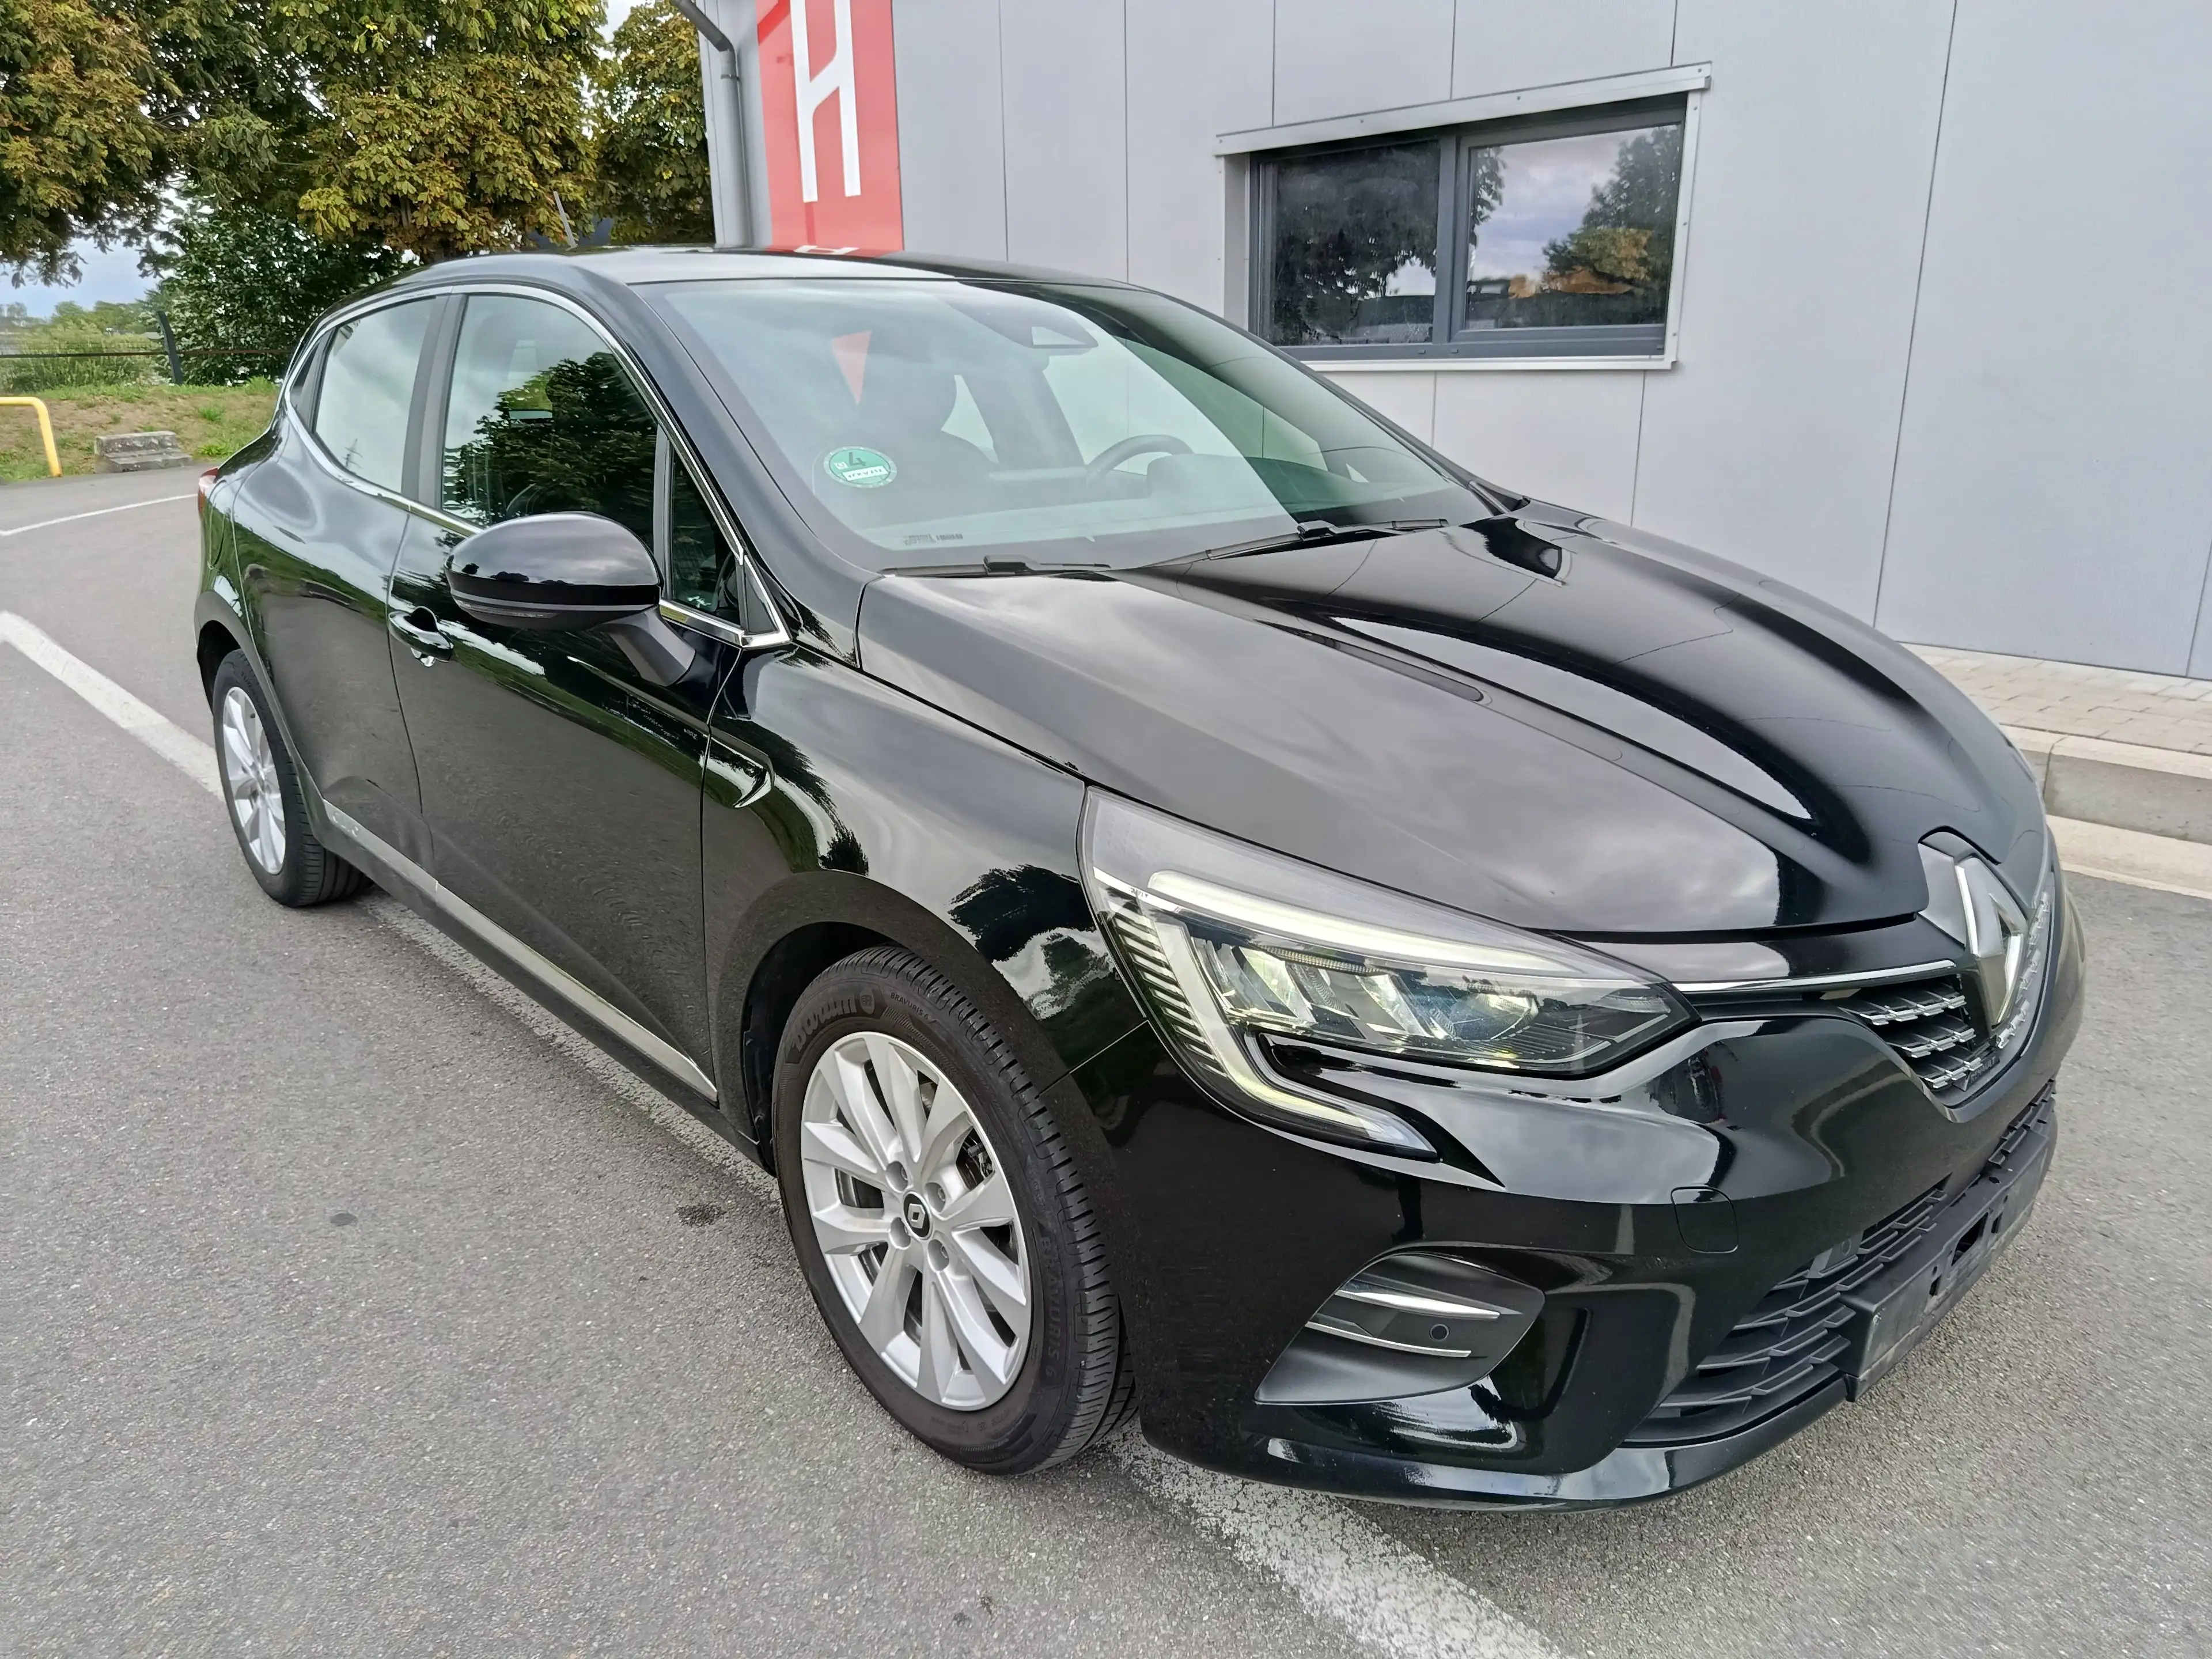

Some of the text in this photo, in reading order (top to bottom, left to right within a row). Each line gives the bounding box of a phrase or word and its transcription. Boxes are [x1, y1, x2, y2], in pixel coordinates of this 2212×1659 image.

[790, 0, 861, 203] H
[849, 452, 866, 466] 4
[890, 992, 923, 1016] BRAVURIS
[1039, 1236, 1062, 1361] BRAVURIS
[1045, 1366, 1058, 1379] 6
